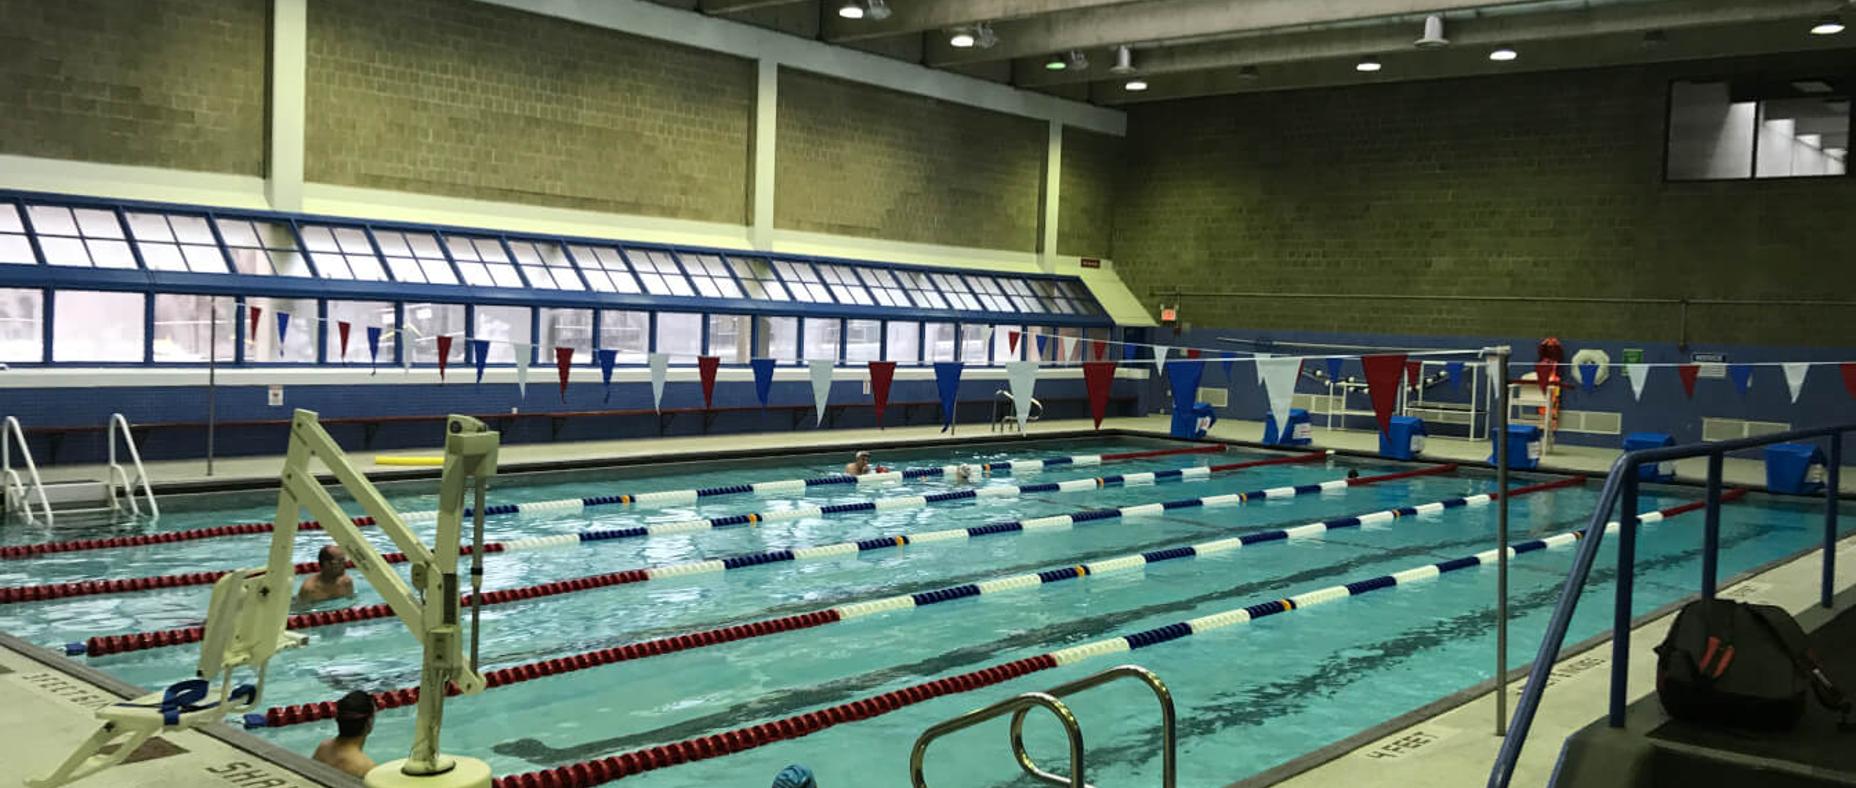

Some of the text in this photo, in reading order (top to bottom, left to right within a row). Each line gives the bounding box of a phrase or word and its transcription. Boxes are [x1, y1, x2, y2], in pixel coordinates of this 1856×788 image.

[1366, 730, 1439, 759] 4 FEET
[204, 761, 298, 788] SHA
